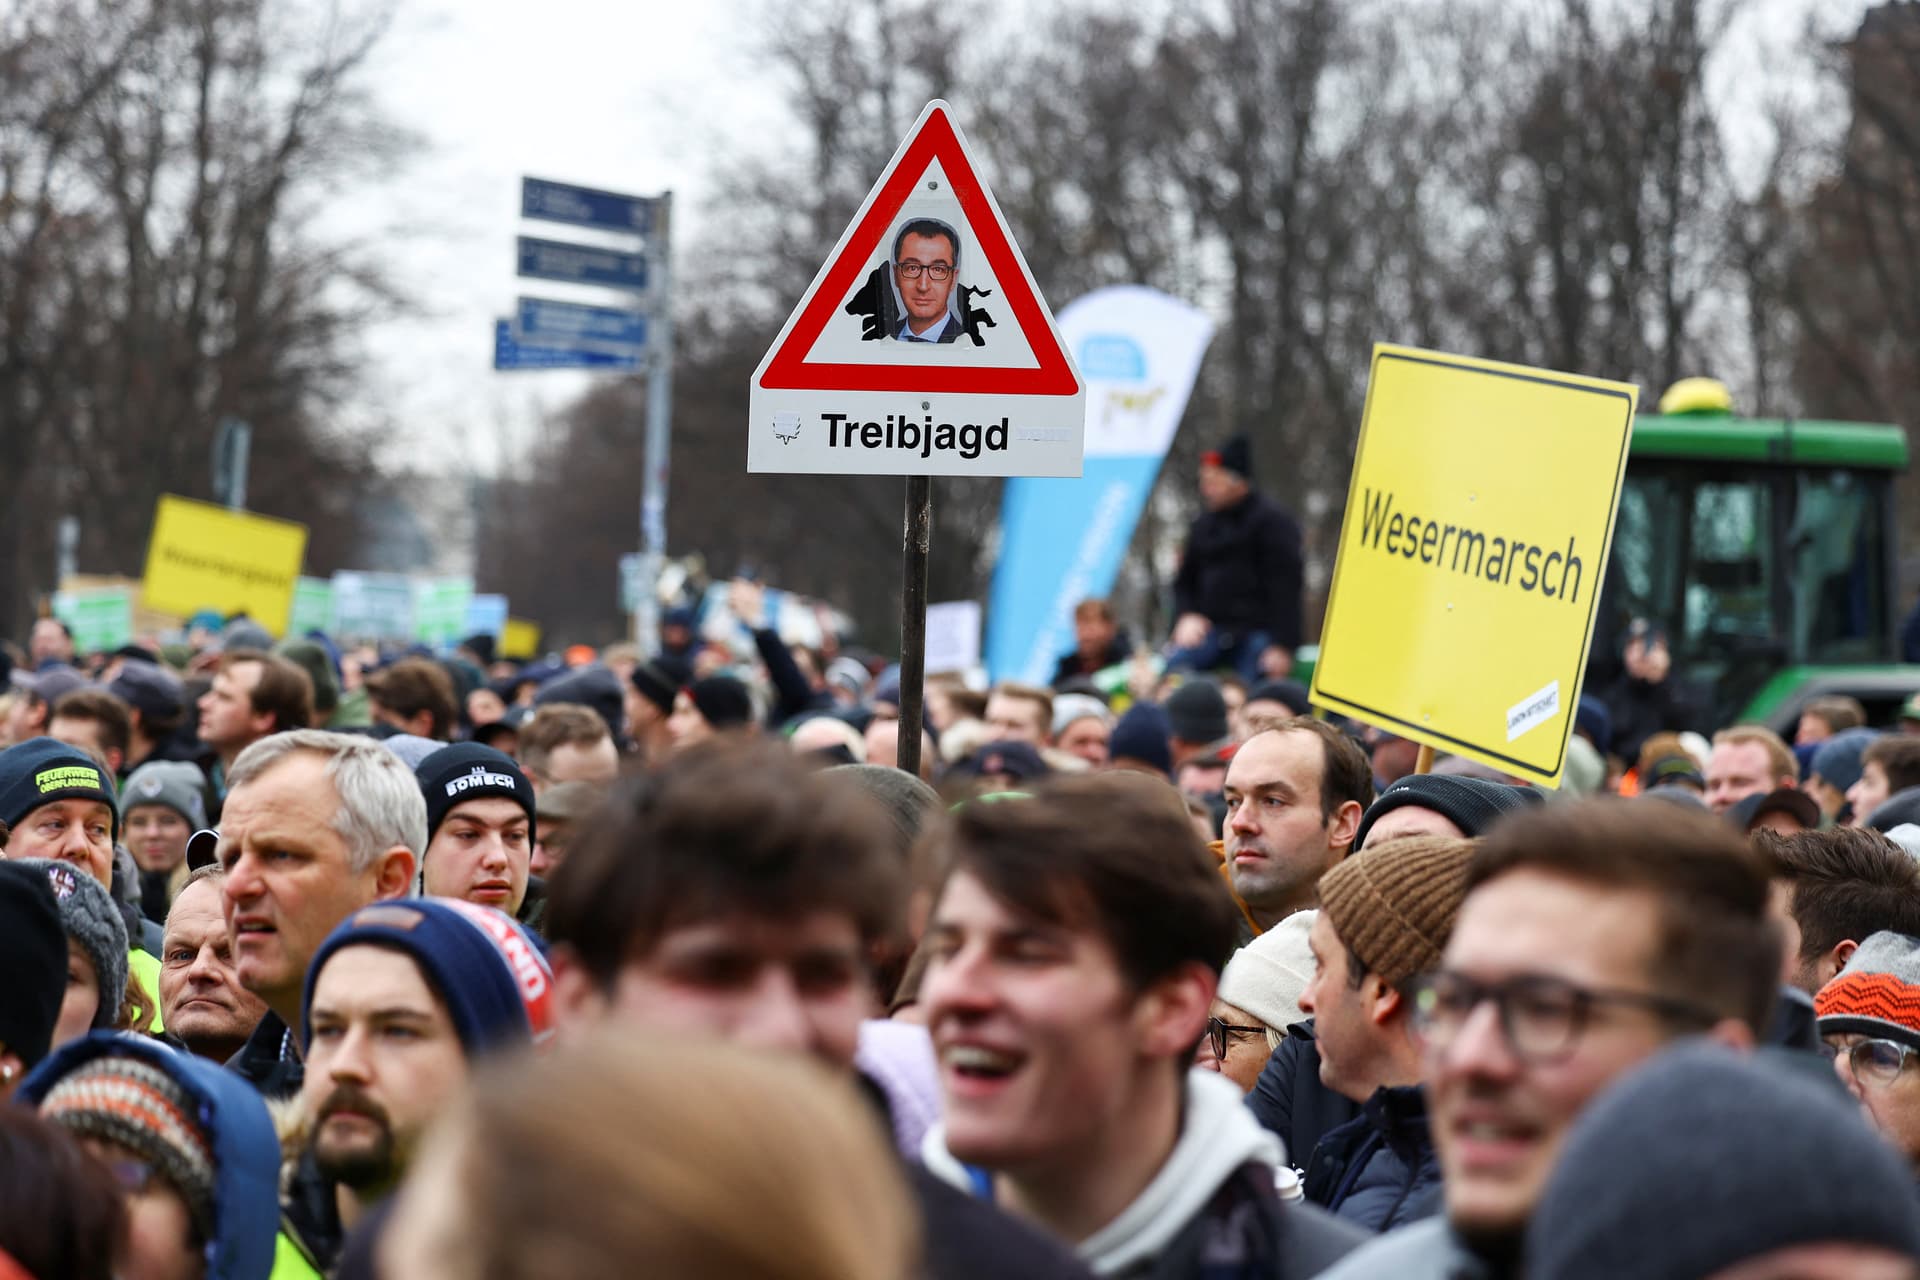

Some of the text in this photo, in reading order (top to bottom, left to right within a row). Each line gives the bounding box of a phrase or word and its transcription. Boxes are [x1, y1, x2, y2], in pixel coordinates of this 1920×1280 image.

[821, 413, 1008, 459] Treibjagd
[1361, 487, 1583, 604] Wesermarsch
[36, 767, 99, 786] FEUERWEHR
